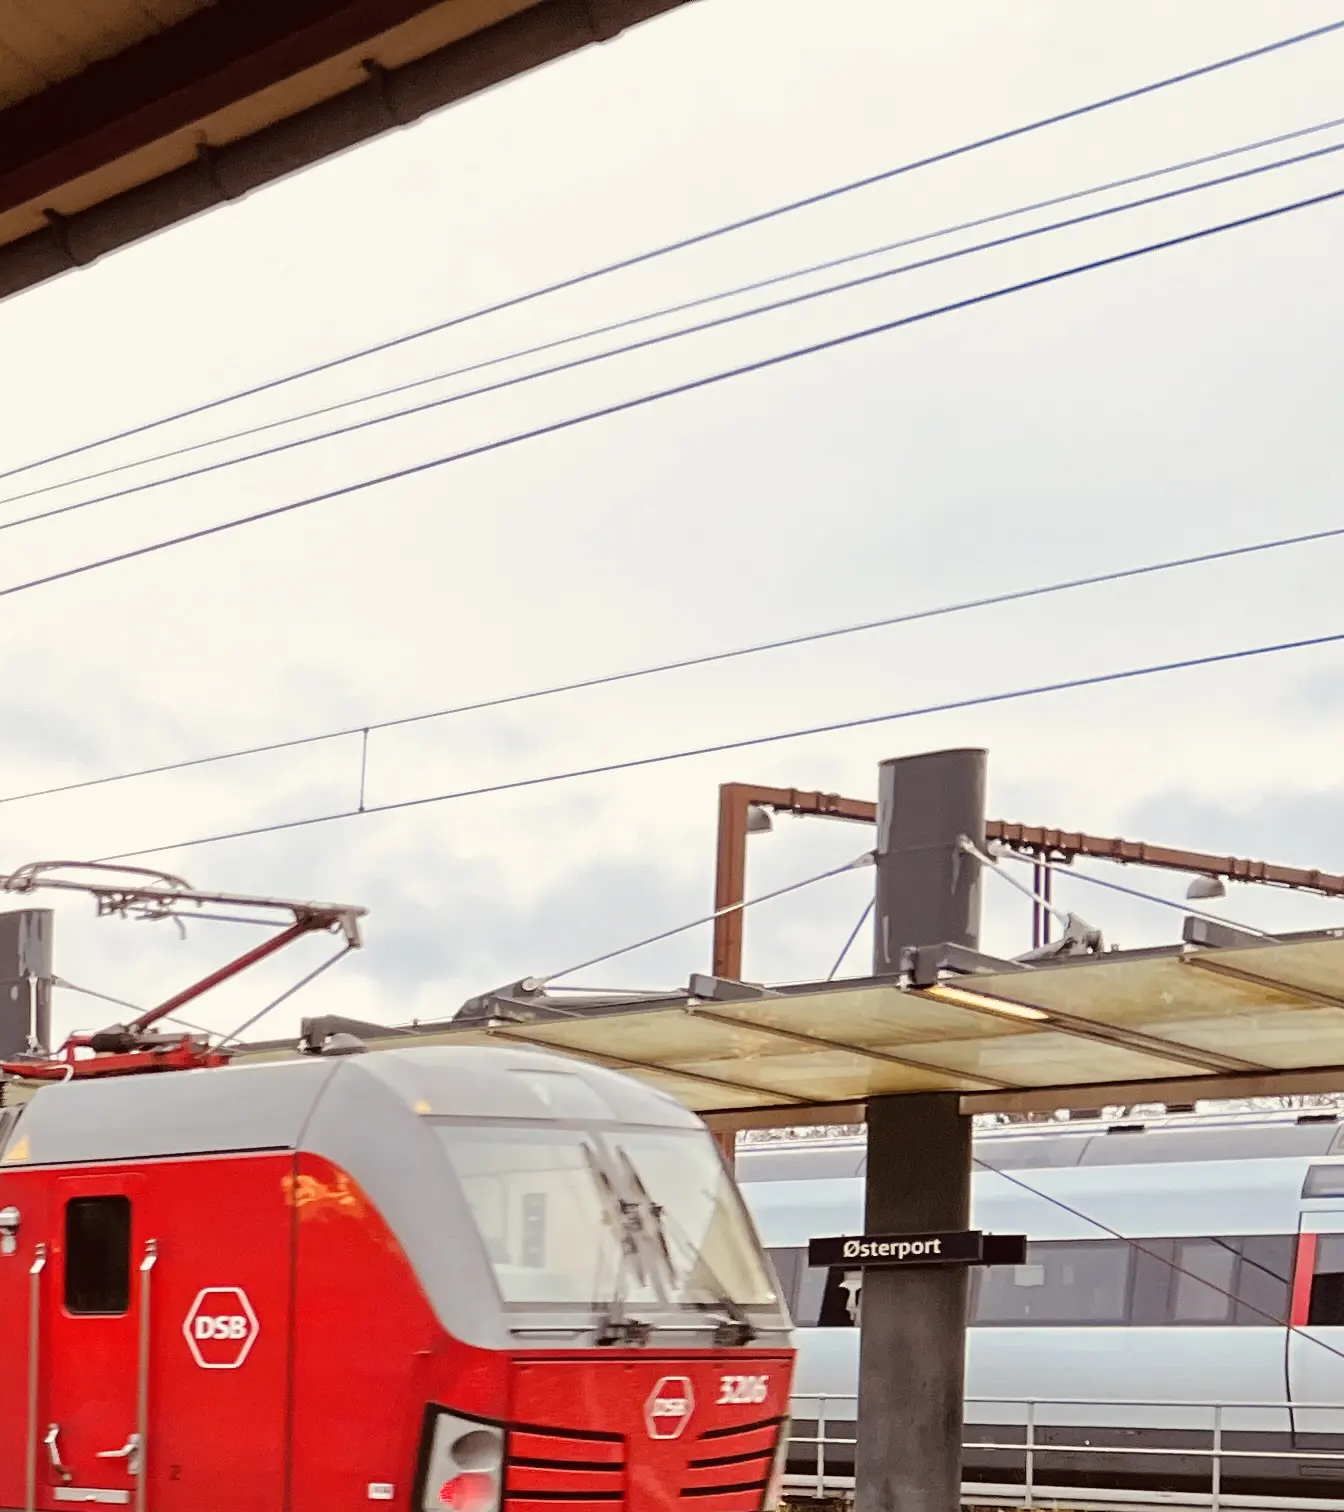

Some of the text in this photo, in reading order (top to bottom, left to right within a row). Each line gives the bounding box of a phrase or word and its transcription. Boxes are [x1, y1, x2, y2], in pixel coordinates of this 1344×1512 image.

[843, 1238, 942, 1259] Østerport
[195, 1315, 247, 1340] DSB
[715, 1375, 769, 1405] 3206
